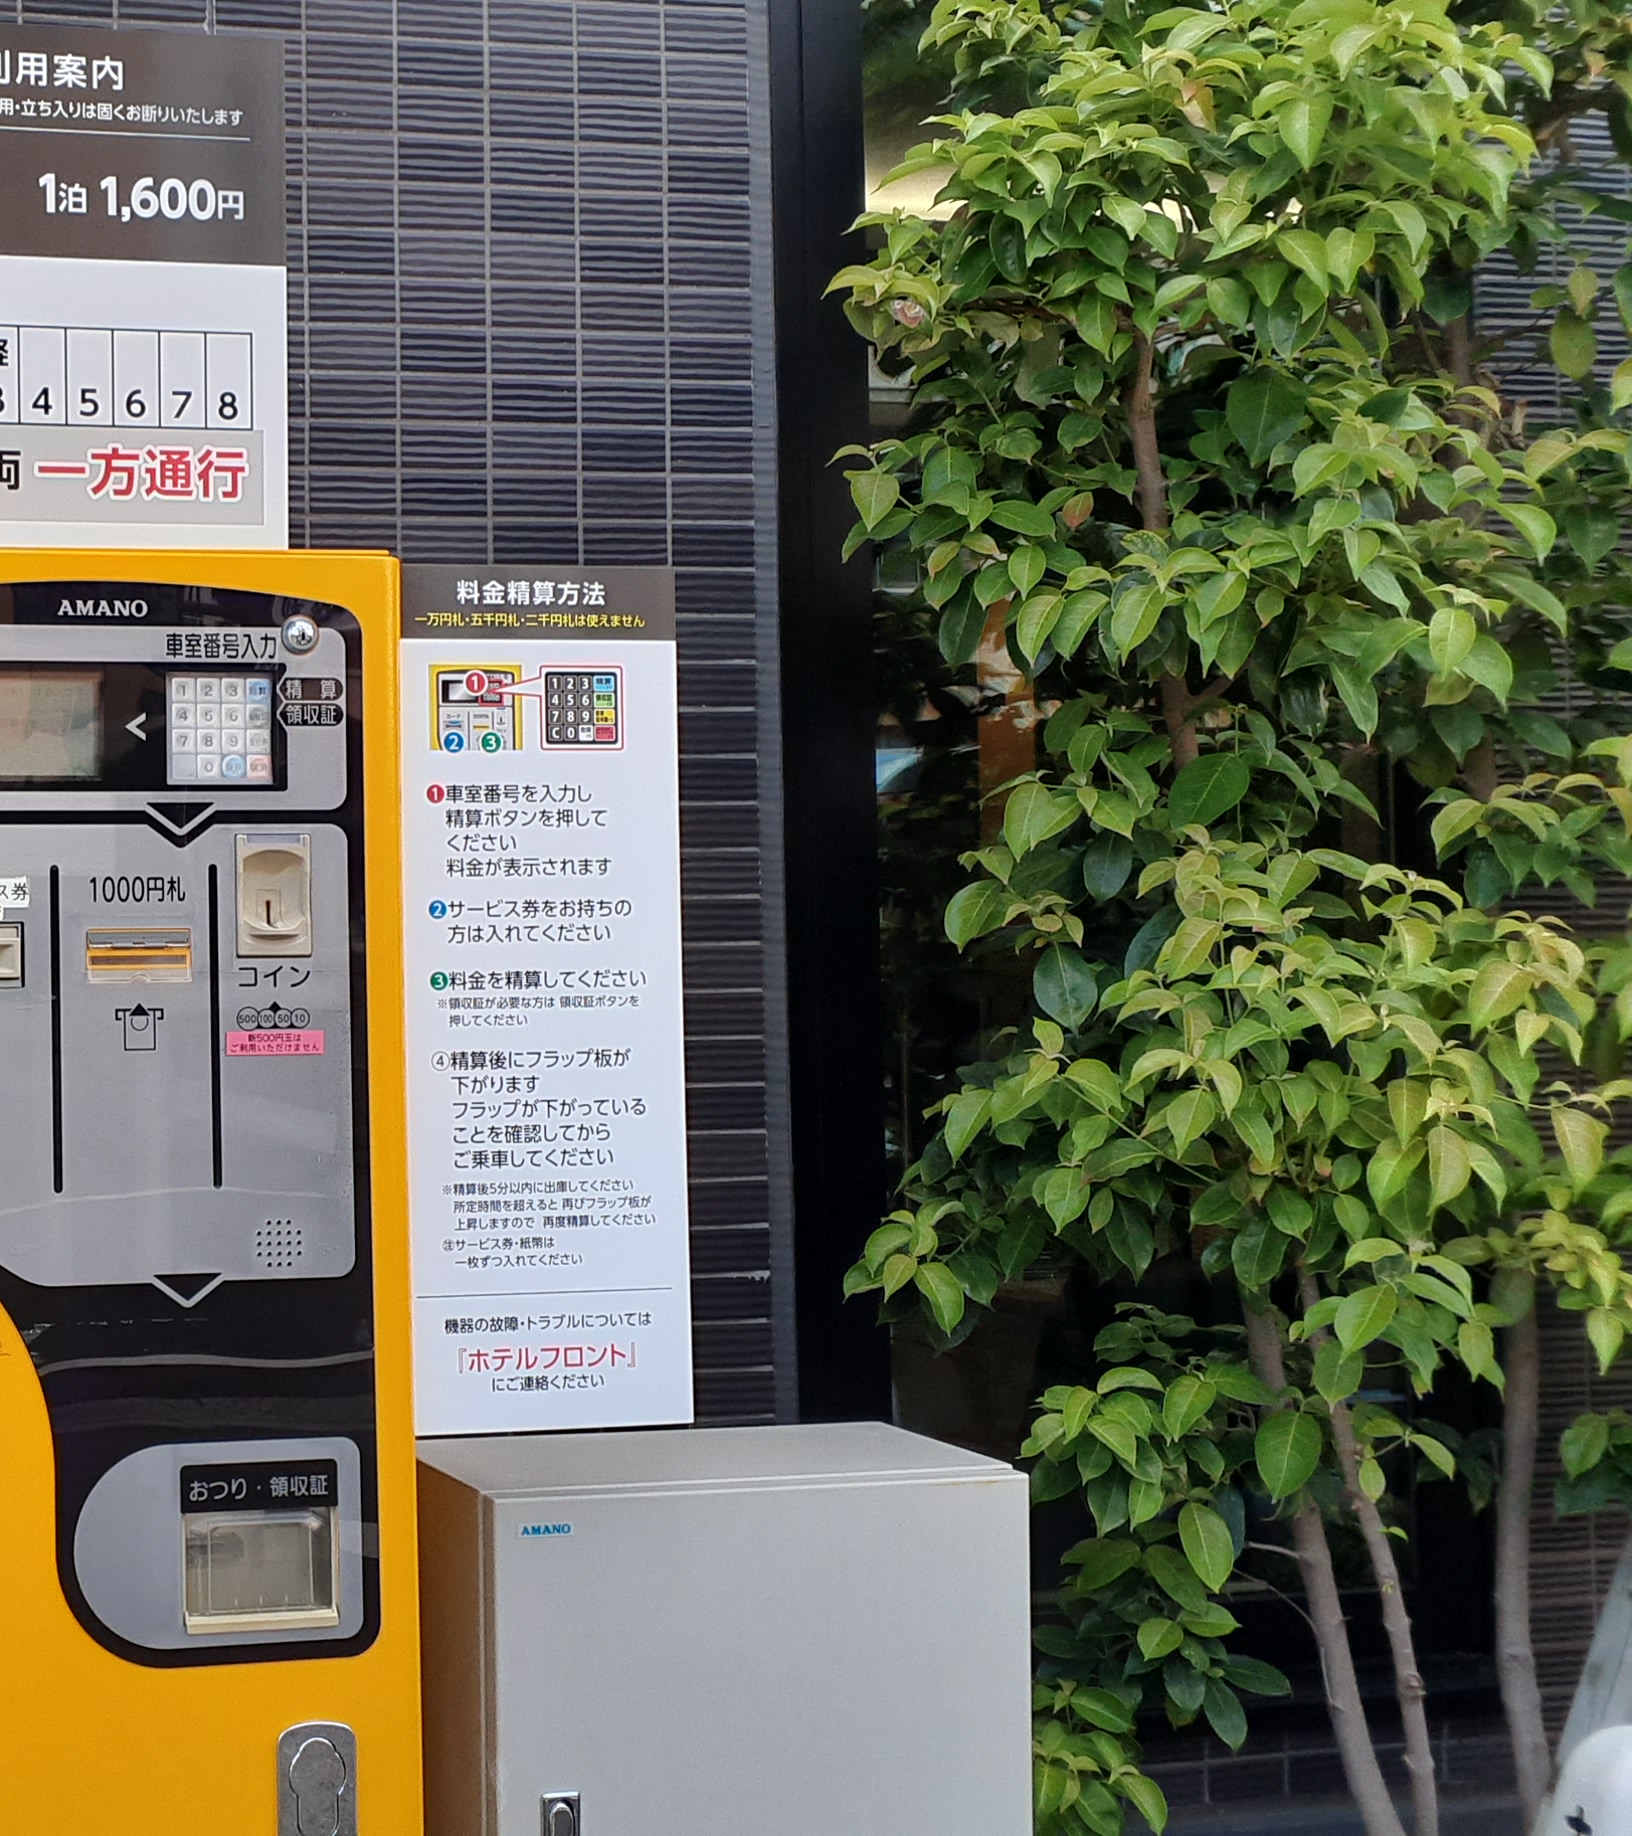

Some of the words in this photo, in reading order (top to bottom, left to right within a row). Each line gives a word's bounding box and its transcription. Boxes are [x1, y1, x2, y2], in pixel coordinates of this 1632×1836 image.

[38, 173, 87, 214] 1泊
[100, 176, 244, 222] 1,600円
[31, 387, 53, 415] 4
[79, 388, 99, 417] 5
[125, 389, 146, 418] 6
[172, 391, 193, 419] 7
[218, 392, 238, 420] 8
[37, 447, 246, 499] 一方通行
[456, 580, 606, 606] 料金精算方法
[57, 600, 148, 618] AMANO
[414, 612, 646, 629] 一万円札・五千円札・二千円札は使えません
[166, 633, 277, 660] 車室番号入力
[179, 685, 187, 697] 1
[204, 685, 213, 697] 2
[229, 685, 238, 697] 3
[552, 677, 558, 689] 1
[566, 677, 574, 690] 2
[581, 677, 589, 690] 3
[551, 694, 559, 706] 4
[566, 694, 574, 706] 5
[581, 694, 590, 706] 6
[179, 710, 188, 722] 4
[204, 710, 213, 722] 5
[229, 710, 238, 722] 6
[286, 704, 337, 725] 領収証
[551, 710, 559, 722] 7
[566, 710, 575, 722] 8
[581, 710, 590, 722] 9
[179, 735, 188, 747] 7
[204, 735, 214, 747] 8
[229, 735, 239, 748] 9
[552, 727, 560, 739] C
[567, 727, 575, 739] 0
[204, 761, 214, 773] 0
[445, 809, 608, 828] 精算ボタンを押して
[446, 834, 517, 852] ください
[446, 858, 612, 877] 料金が表示されます
[88, 876, 186, 903] 1000円札
[448, 924, 611, 944] 方は入れてください
[238, 966, 312, 989] コイン
[239, 1014, 257, 1024] 500
[277, 1013, 288, 1023] 50
[294, 1013, 306, 1023] 10
[449, 1014, 528, 1028] 押してください
[451, 1075, 540, 1096] 下がります
[452, 1098, 647, 1120] フラップが下がっている
[453, 1123, 611, 1145] ことを確認してから
[453, 1149, 614, 1170] ご乗車してください
[455, 1253, 583, 1269] 一枚ずつ入れてください
[445, 1311, 652, 1334] 機器の故障・トラブルについては
[491, 1374, 605, 1393] にご連絡ください
[521, 1524, 572, 1536] AMANO
